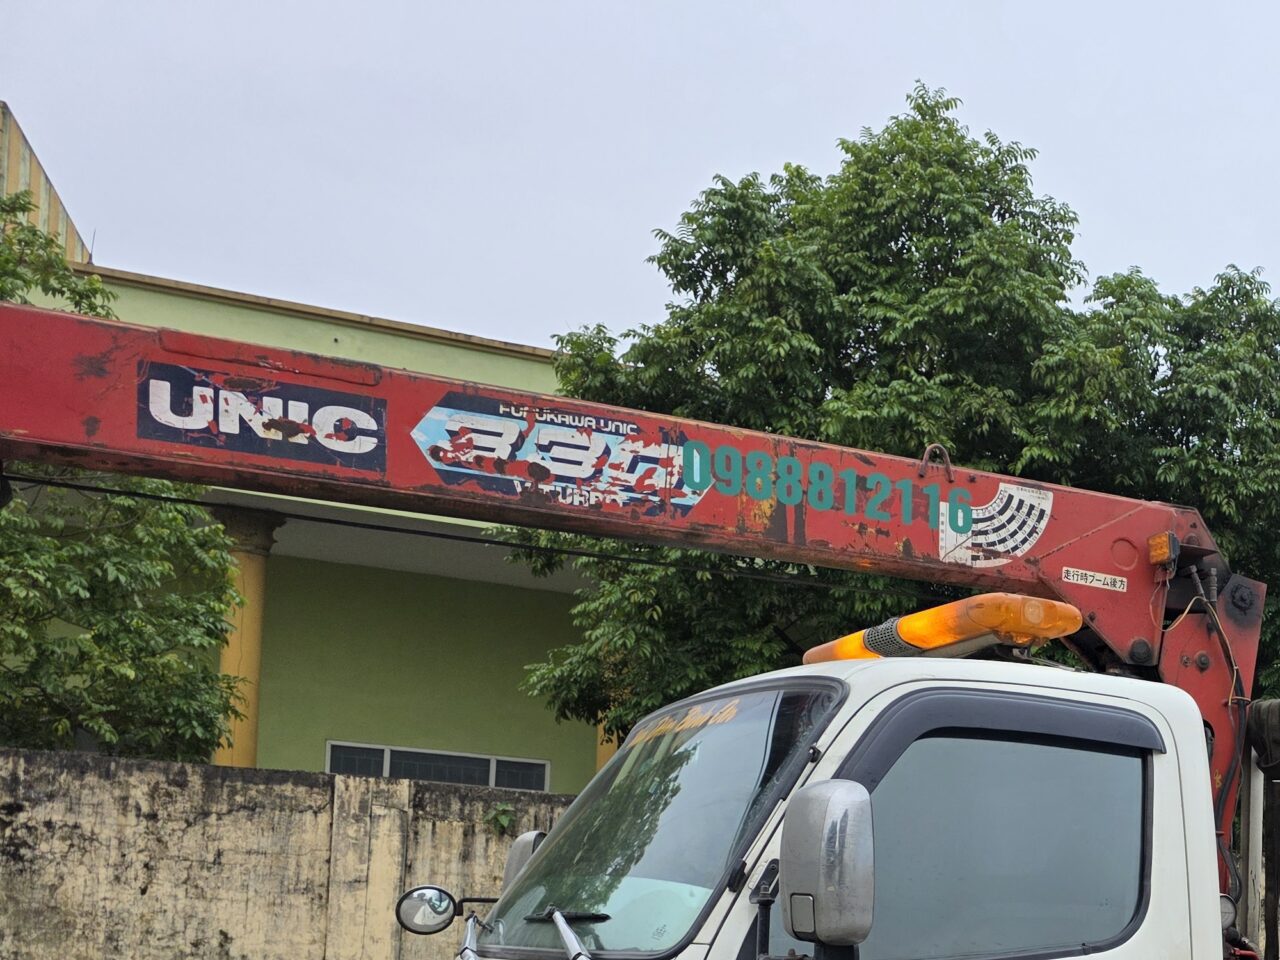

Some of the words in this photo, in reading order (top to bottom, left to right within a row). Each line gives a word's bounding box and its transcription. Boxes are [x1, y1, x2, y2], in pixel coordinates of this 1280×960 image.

[148, 379, 380, 454] UNIC
[599, 418, 638, 435] UNIC
[682, 439, 974, 535] 0988812116
[1063, 568, 1126, 590] 走行時ブーム後方
